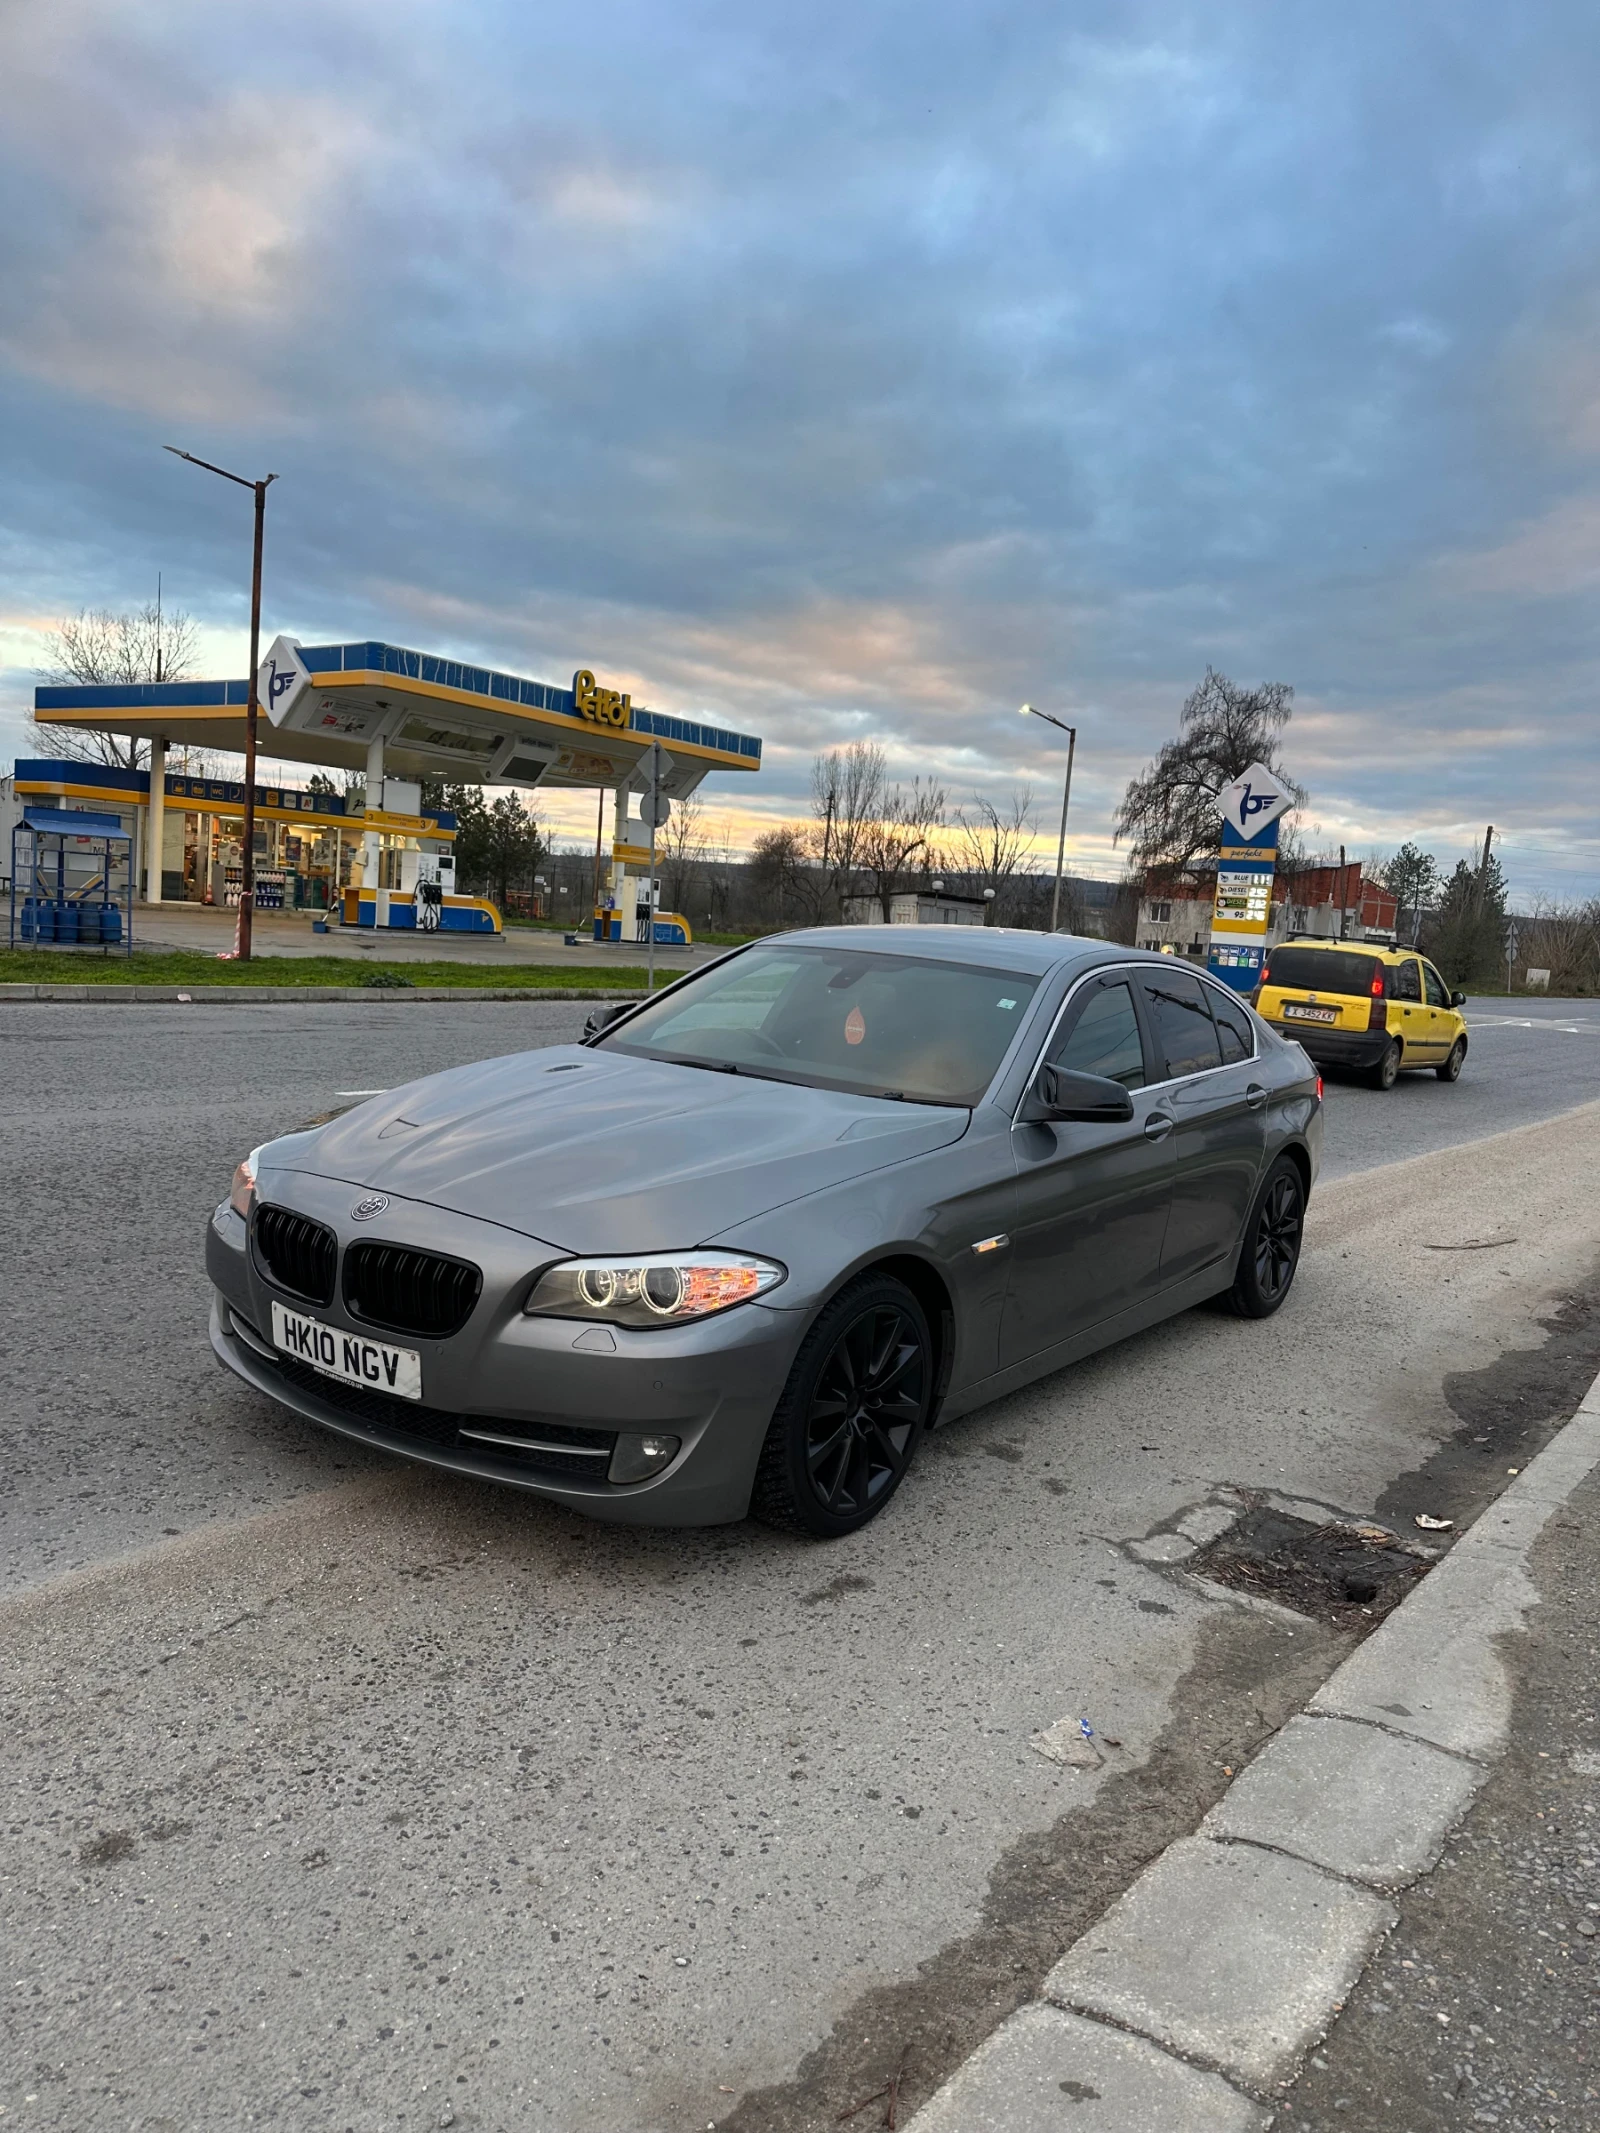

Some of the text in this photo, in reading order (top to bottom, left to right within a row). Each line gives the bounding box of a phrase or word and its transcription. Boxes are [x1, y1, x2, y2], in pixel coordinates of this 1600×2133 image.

[574, 669, 631, 728] Petrol
[368, 813, 374, 821] 3
[420, 819, 426, 829] 3
[1234, 911, 1245, 919] 95
[343, 1337, 399, 1388] NGV
